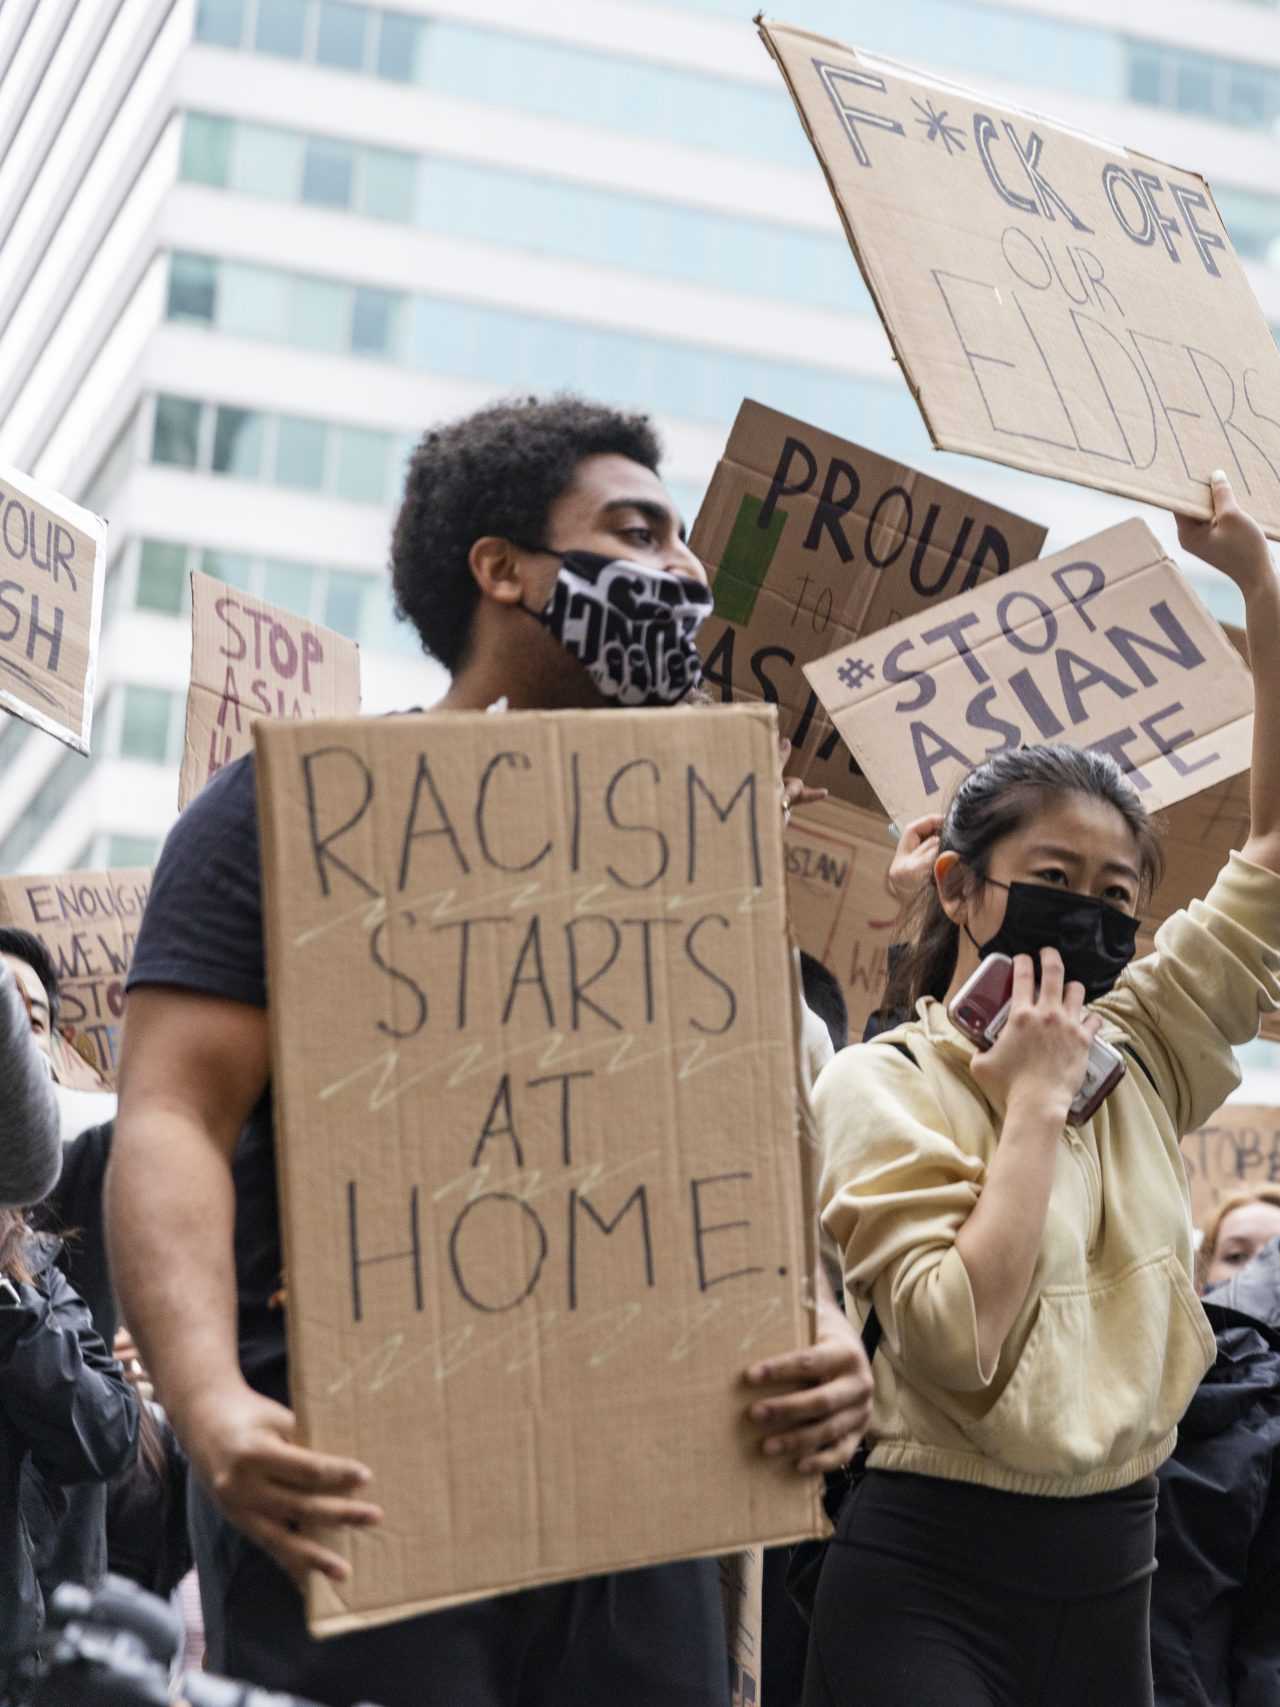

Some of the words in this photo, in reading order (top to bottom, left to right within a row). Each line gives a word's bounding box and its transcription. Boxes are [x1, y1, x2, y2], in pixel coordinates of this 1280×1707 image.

[1102, 163, 1226, 279] OFF
[1001, 227, 1126, 318] OUR
[0, 490, 77, 592] OUR
[215, 598, 324, 695] STOP
[837, 560, 1106, 712] #STOP
[909, 600, 1206, 796] ASIAN
[1083, 701, 1221, 792] TE
[302, 746, 763, 898] RACISM
[786, 846, 848, 889] SIAN
[57, 981, 128, 1023] STO
[370, 914, 738, 1038] STARTS
[471, 1072, 594, 1167] AT
[348, 1171, 788, 1323] HOME.
